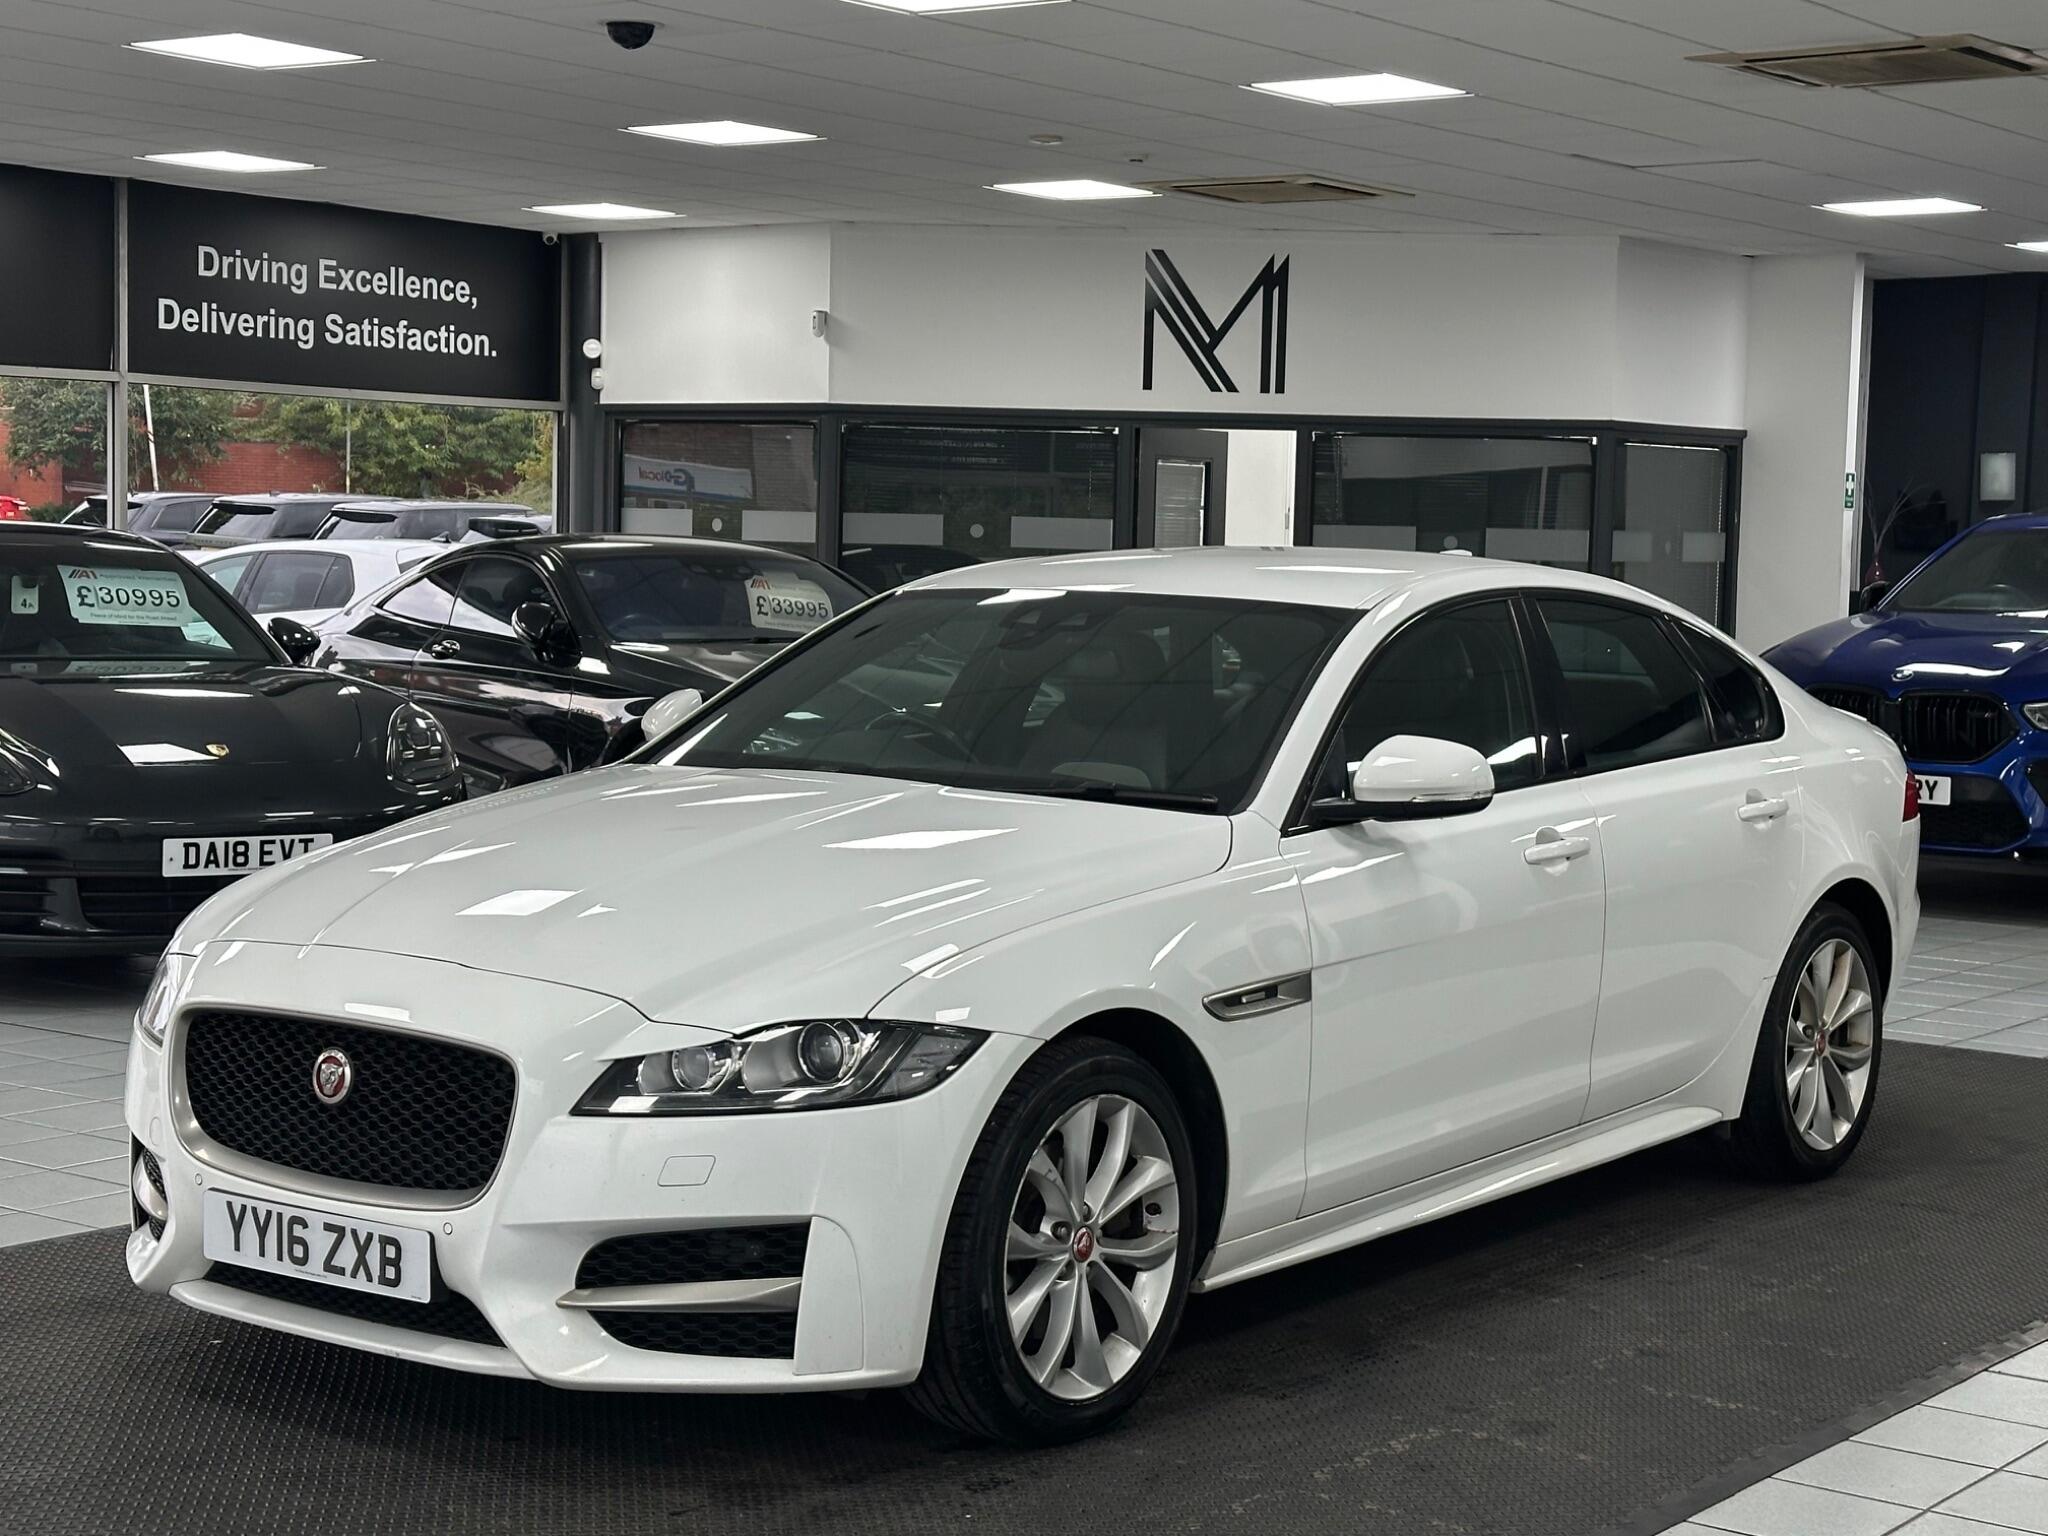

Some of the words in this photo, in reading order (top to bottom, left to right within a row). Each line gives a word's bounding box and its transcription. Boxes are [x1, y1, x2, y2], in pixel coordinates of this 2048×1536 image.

[198, 245, 308, 294] Driving
[318, 258, 477, 309] Excellence,
[158, 298, 314, 350] Delivering
[324, 313, 497, 357] Satisfaction.
[182, 840, 250, 869] DA18
[259, 838, 315, 866] EVT
[226, 1201, 309, 1267] YY16
[323, 1221, 402, 1288] ZXB
